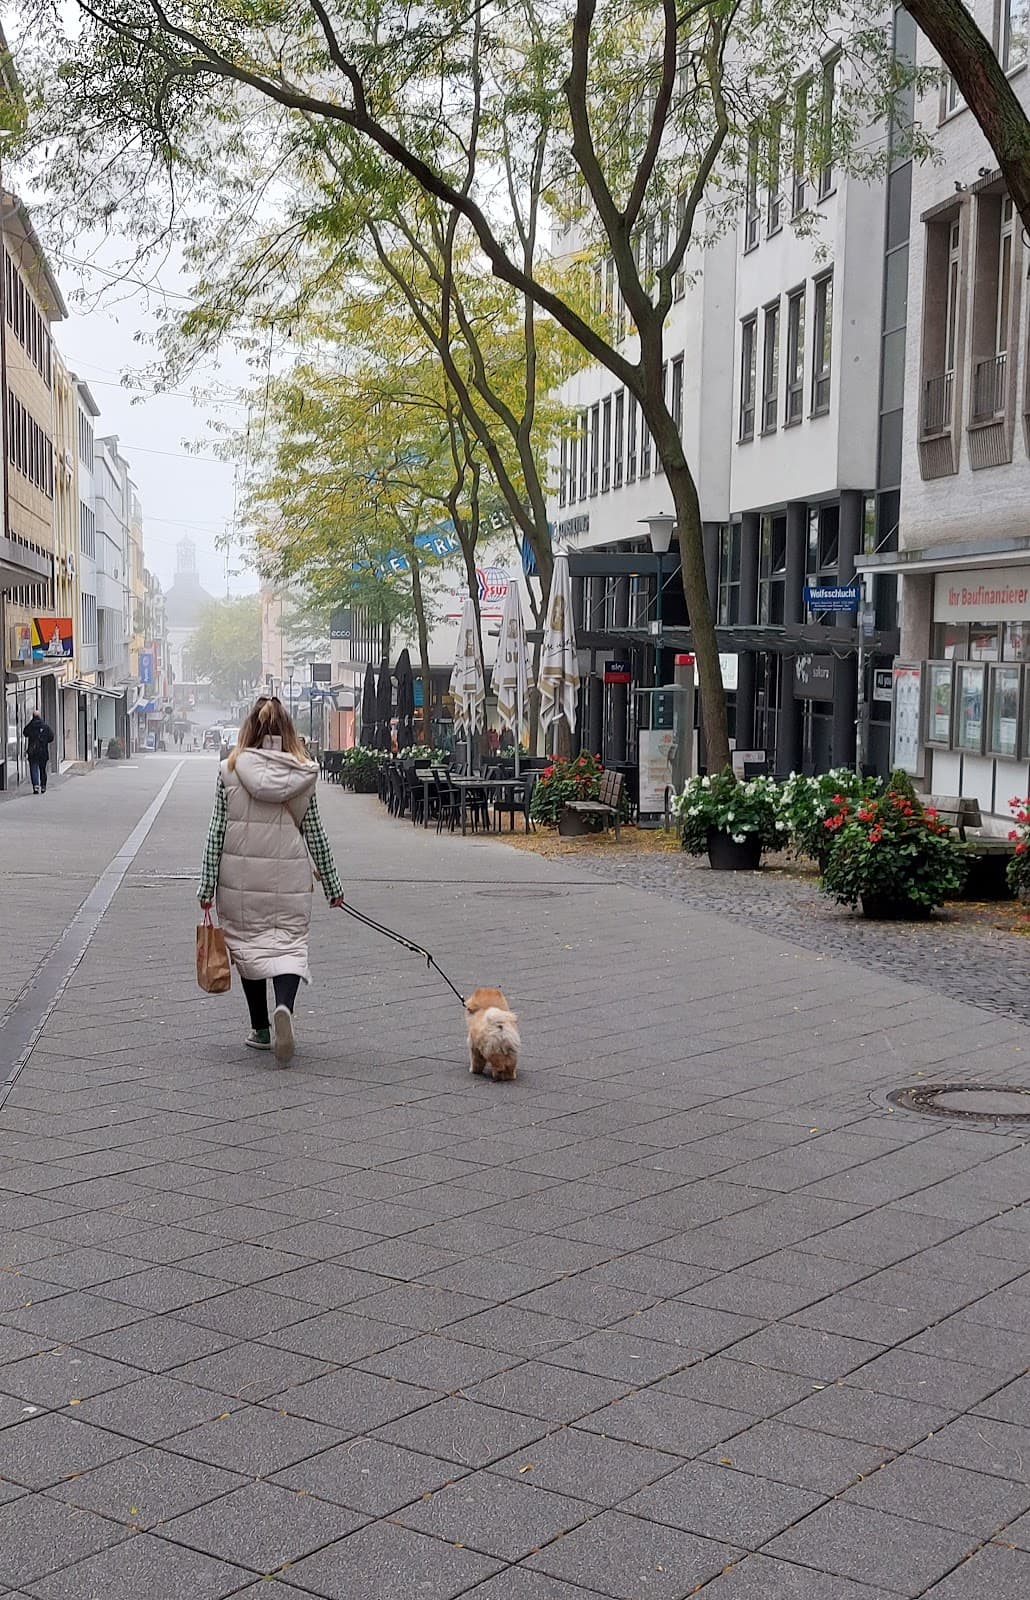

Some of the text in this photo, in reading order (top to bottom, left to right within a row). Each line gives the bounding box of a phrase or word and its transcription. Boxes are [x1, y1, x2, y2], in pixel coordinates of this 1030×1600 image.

[809, 588, 857, 599] Wolfsschlucht
[948, 584, 1028, 607] Ihr Baufinanzierer
[611, 663, 625, 672] sky
